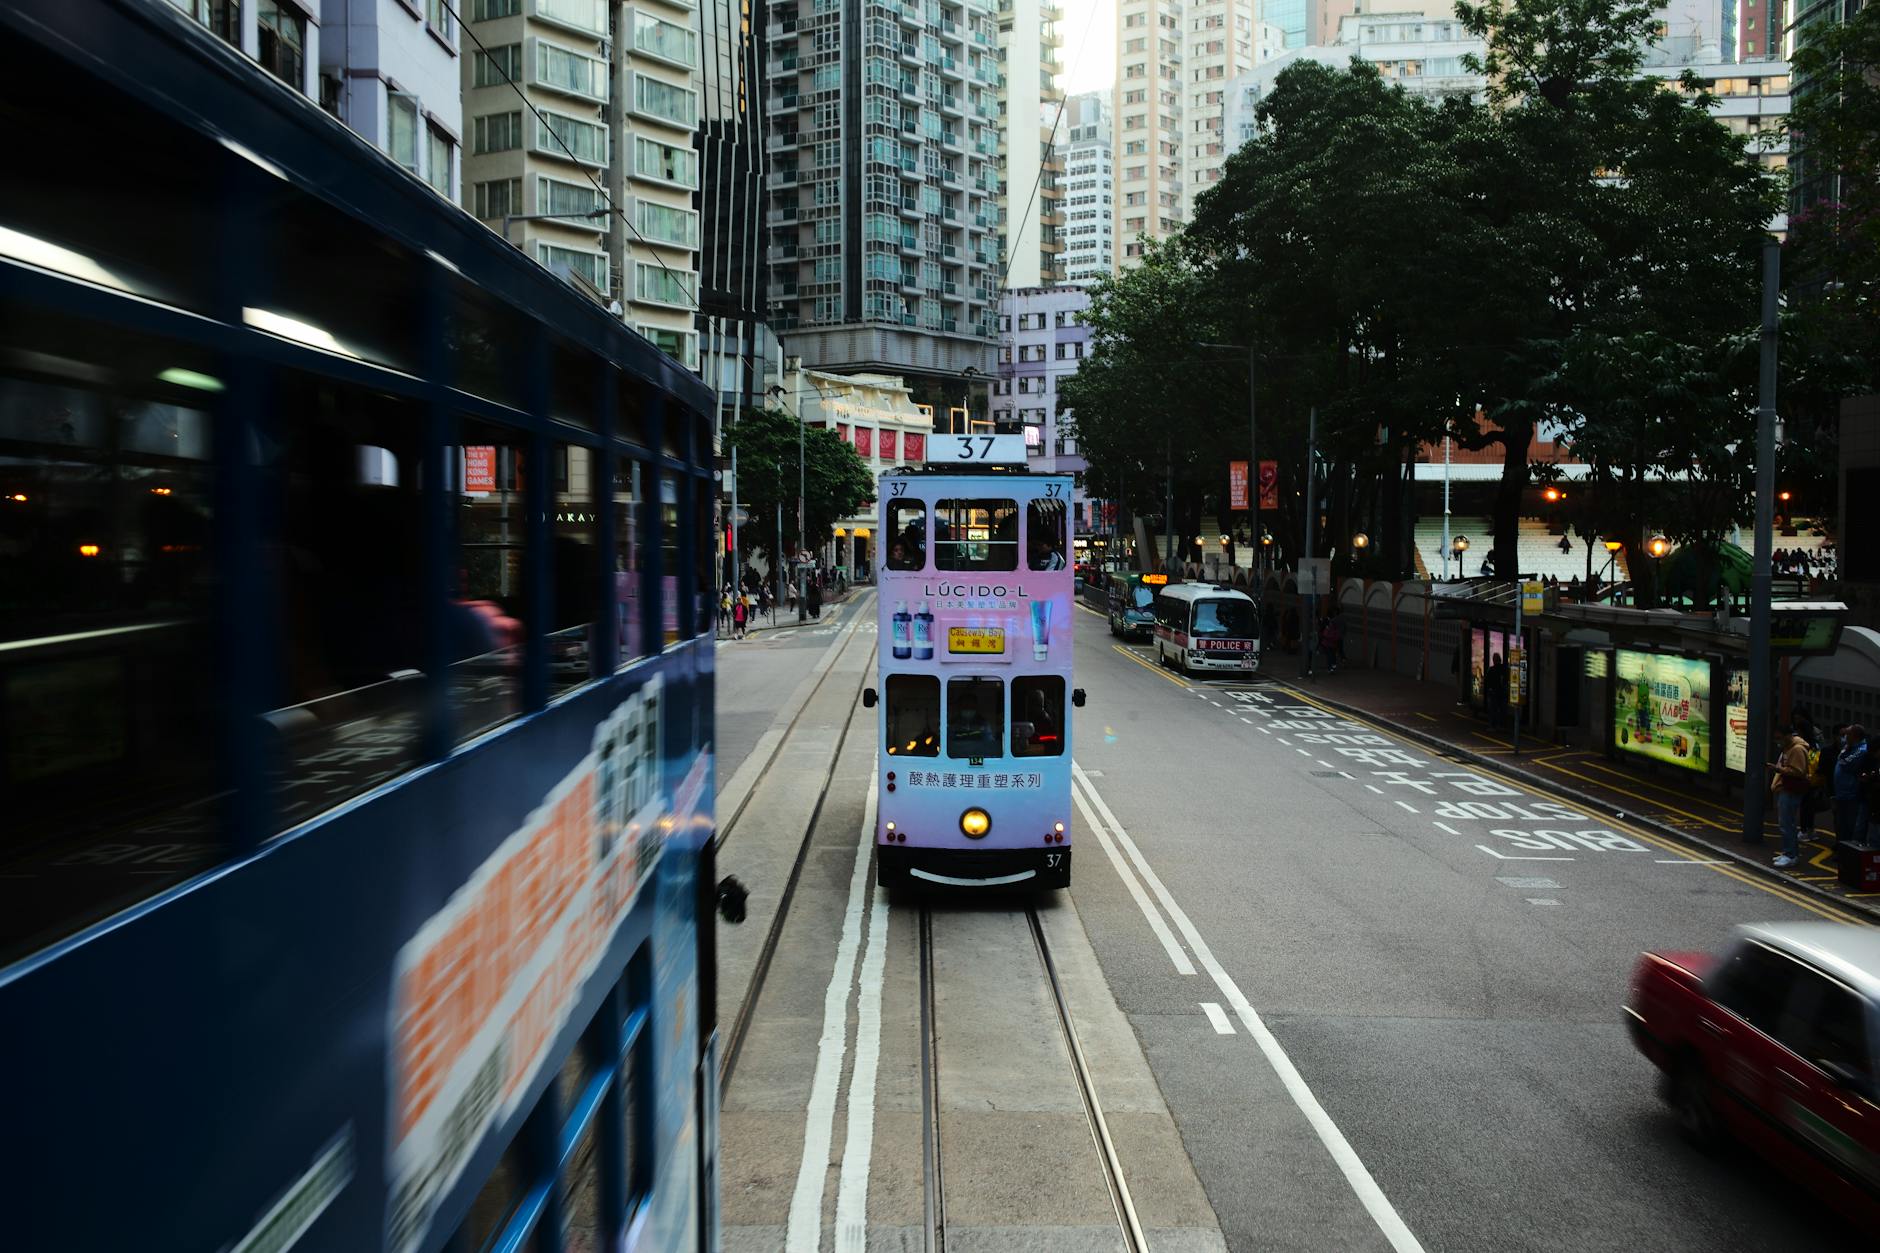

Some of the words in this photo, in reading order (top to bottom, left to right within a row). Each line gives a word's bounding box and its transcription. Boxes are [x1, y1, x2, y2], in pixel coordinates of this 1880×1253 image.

[957, 436, 995, 459] 37
[891, 482, 908, 497] 37
[1045, 483, 1062, 497] 37
[925, 581, 1028, 597] LÚCIDO-L
[950, 627, 986, 639] Causeway
[988, 628, 1002, 639] Bay
[1210, 640, 1241, 650] POLICE
[1267, 719, 1371, 732] STOP
[1294, 733, 1396, 746] BUS
[908, 771, 1041, 789] 酸熱護理重塑系列
[1433, 801, 1590, 821] STOP
[1488, 829, 1652, 852] BUS
[1046, 854, 1062, 868] 37
